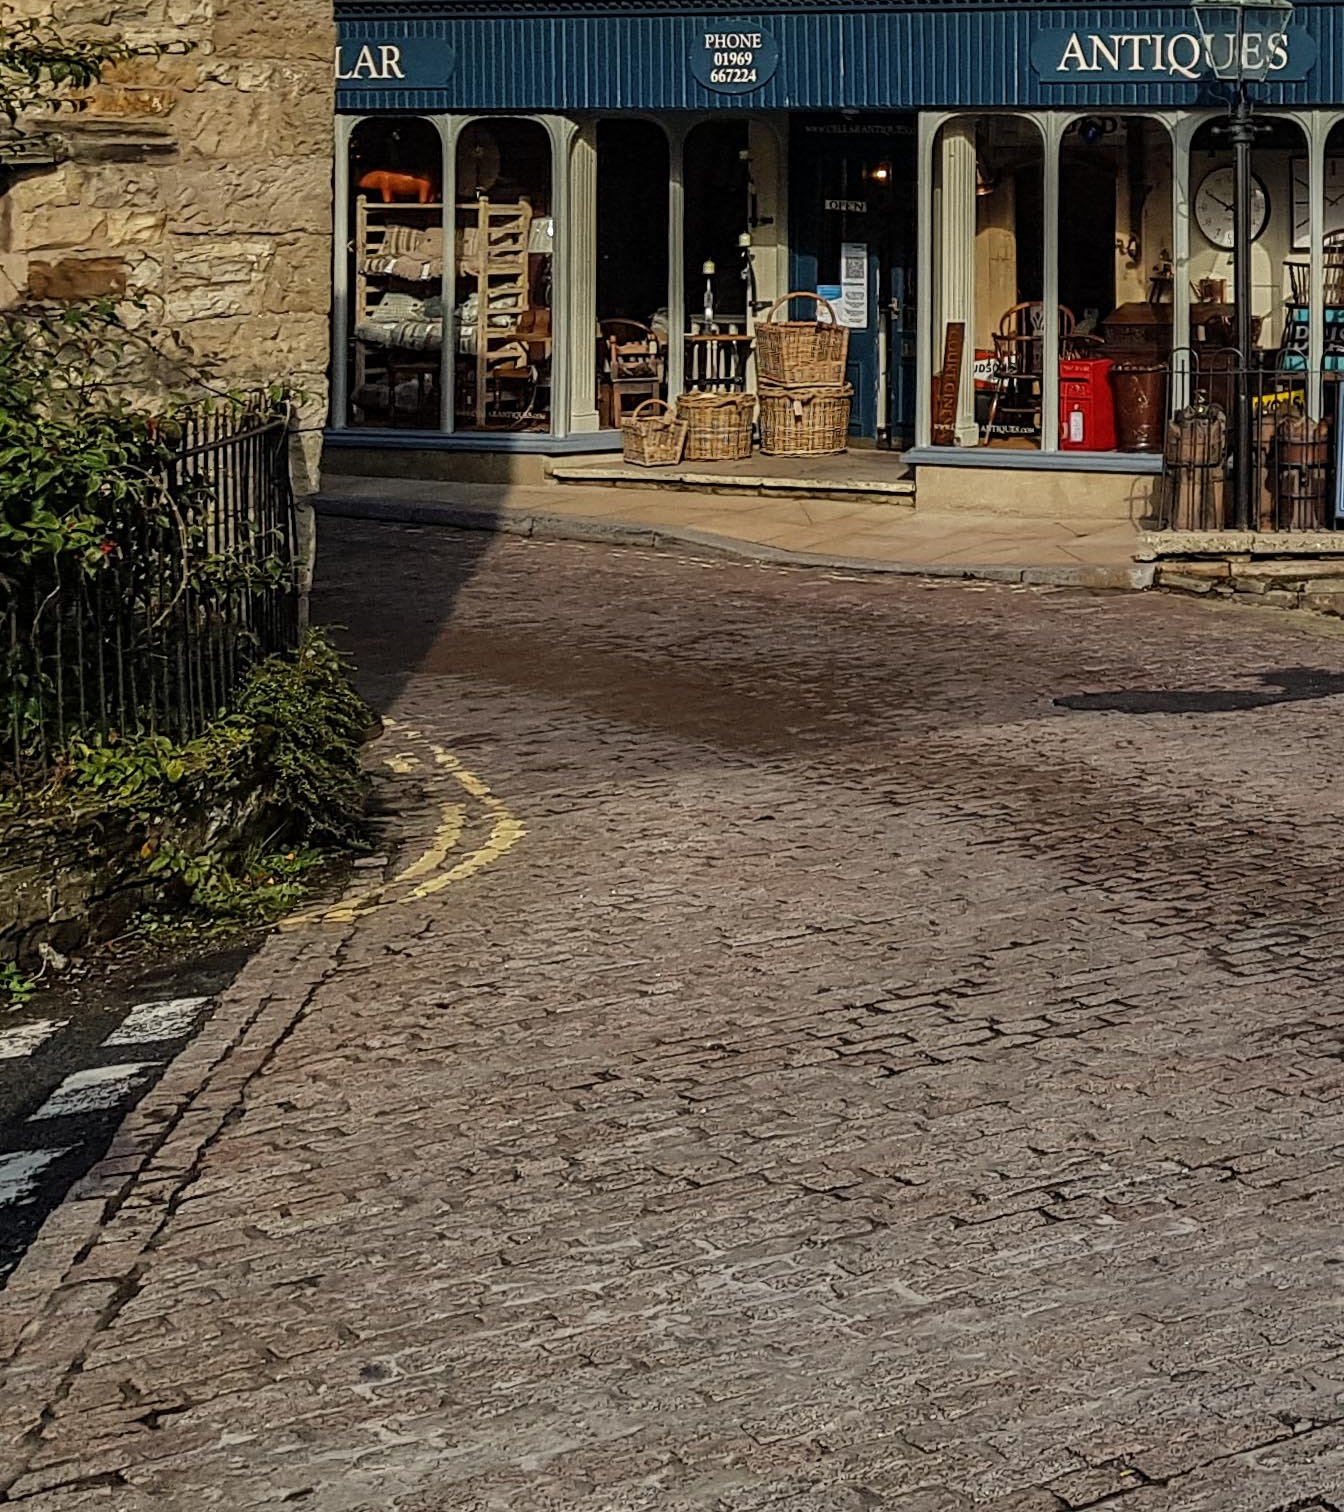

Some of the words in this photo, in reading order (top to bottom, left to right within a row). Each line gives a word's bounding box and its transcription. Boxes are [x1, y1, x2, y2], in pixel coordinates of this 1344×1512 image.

[704, 33, 762, 48] PHONE
[713, 51, 752, 66] 01969
[1056, 32, 1288, 79] ANTIQUES
[710, 68, 757, 83] 667224
[829, 200, 864, 212] OPEN
